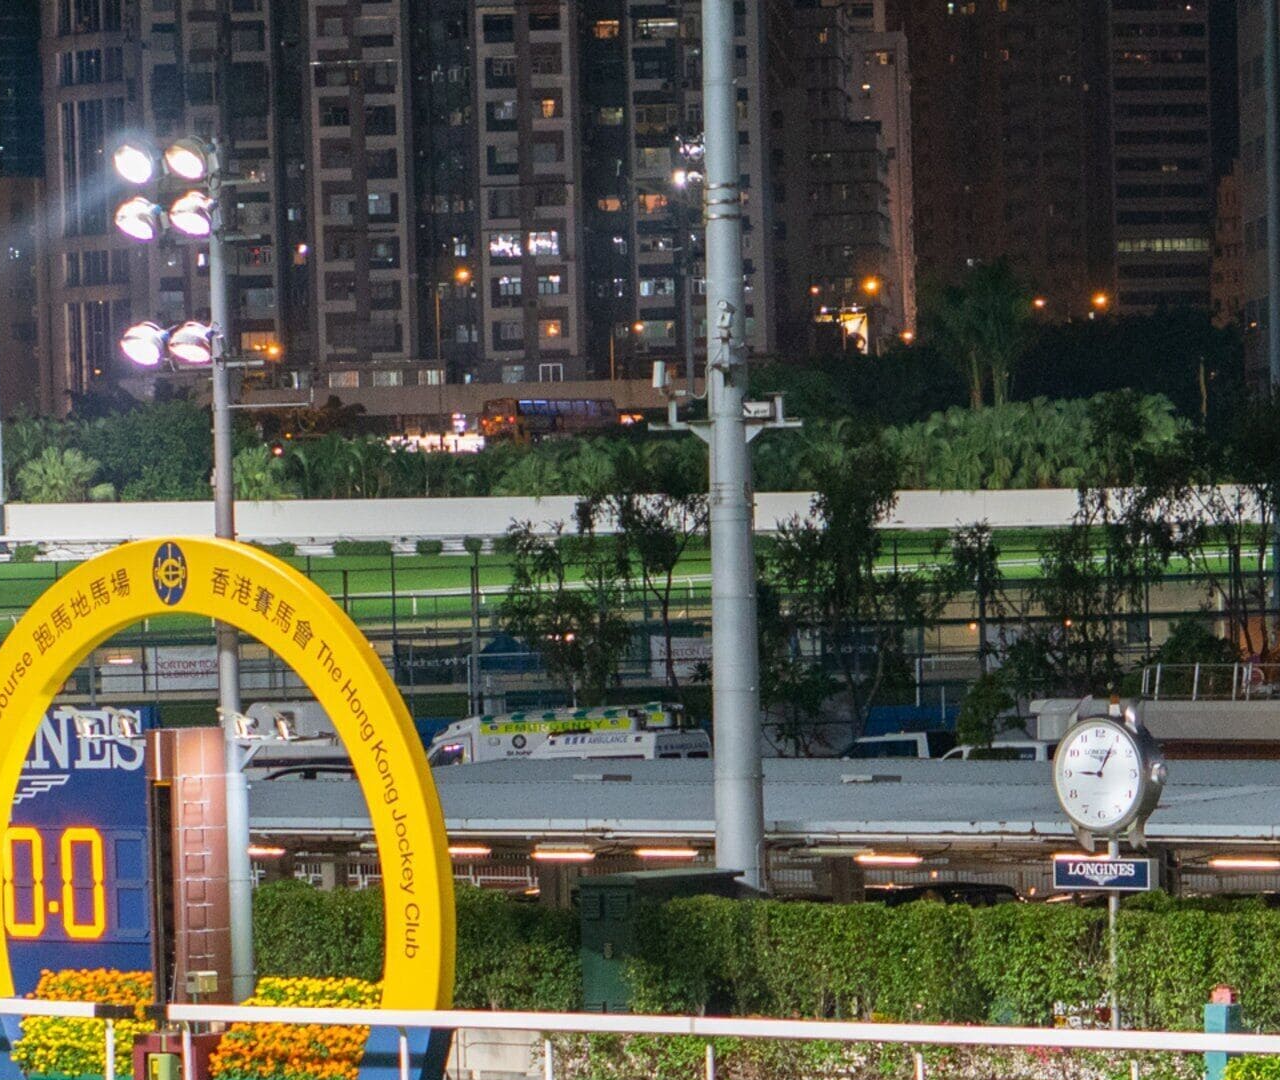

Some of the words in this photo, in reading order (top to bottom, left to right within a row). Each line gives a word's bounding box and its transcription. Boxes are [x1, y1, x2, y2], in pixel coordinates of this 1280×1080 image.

[32, 568, 131, 656] 跑馬地馬場
[211, 567, 315, 651] 香港賽馬會
[316, 640, 343, 683] The
[341, 679, 376, 741] Hong
[371, 740, 399, 805] Kong
[392, 808, 415, 896] Jockey
[404, 903, 420, 959] Club
[587, 735, 629, 745] AMBULANCE
[4, 827, 106, 939] 0.0
[1068, 862, 1135, 876] LONGINES
